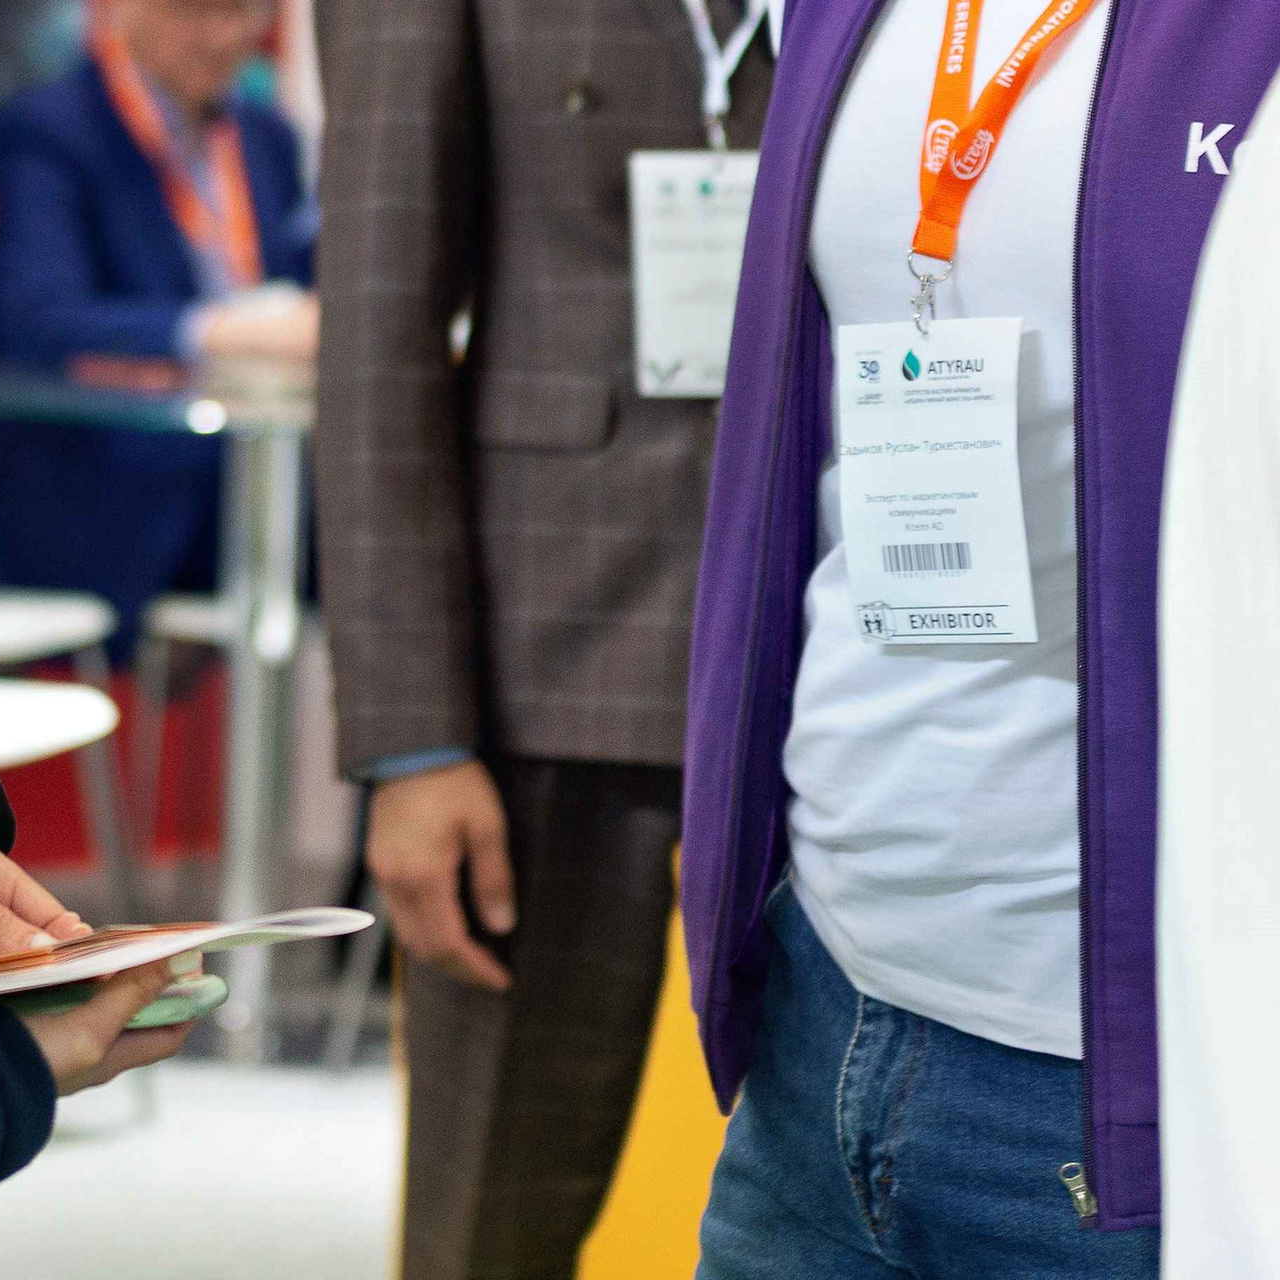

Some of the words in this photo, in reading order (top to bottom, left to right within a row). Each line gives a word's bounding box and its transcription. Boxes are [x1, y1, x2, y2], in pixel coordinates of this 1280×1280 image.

[1184, 122, 1248, 176] K
[927, 358, 985, 375] ATYRAU
[909, 612, 997, 629] EXHIBITOR
